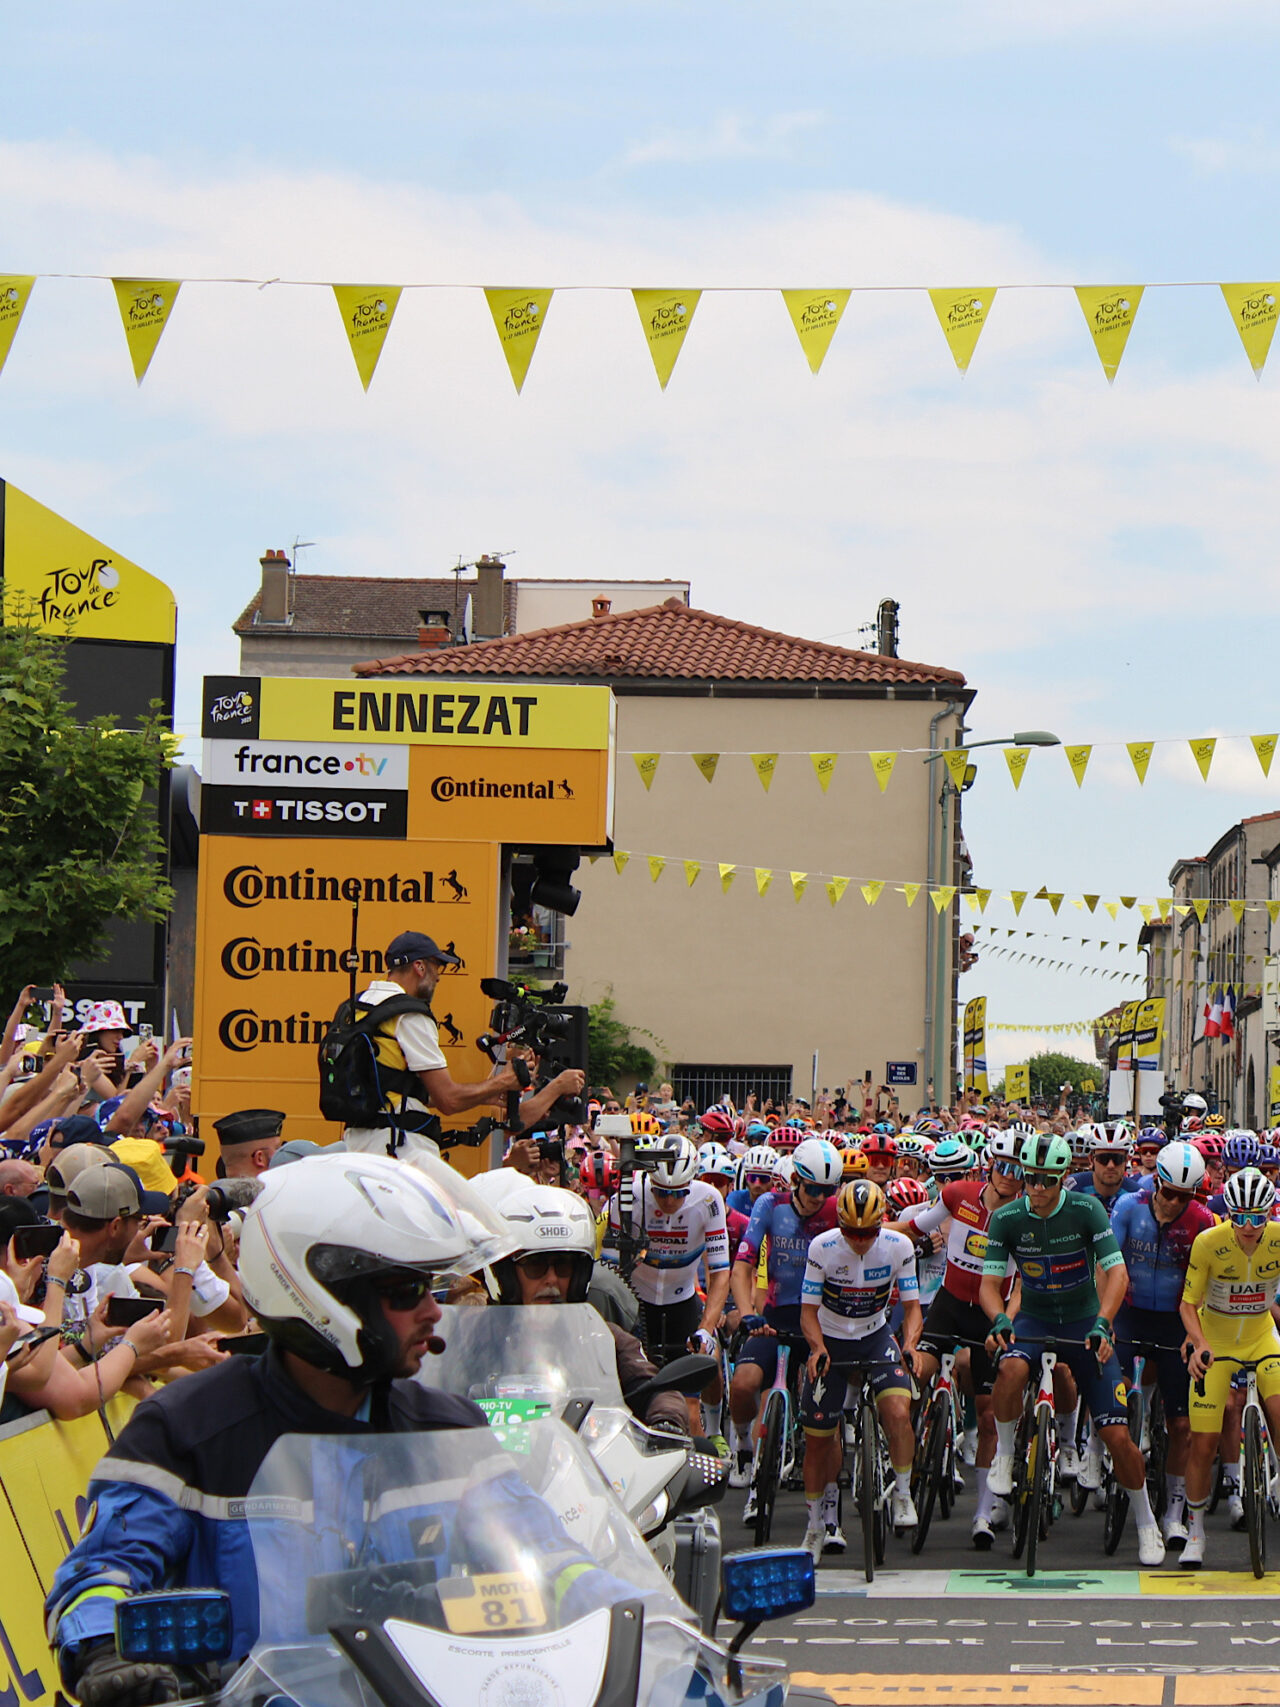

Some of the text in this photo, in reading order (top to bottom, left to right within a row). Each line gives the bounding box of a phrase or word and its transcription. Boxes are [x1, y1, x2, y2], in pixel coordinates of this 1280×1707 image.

[89, 582, 100, 595] de
[332, 690, 538, 736] ENNEZAT
[430, 775, 555, 802] Continental
[276, 800, 387, 823] TISSOT
[223, 864, 435, 908] Continental
[221, 935, 386, 980] Continen
[505, 1025, 527, 1041] RONIN
[960, 1199, 982, 1214] Santini
[539, 1227, 569, 1236] SHOEI
[772, 1236, 807, 1251] ISRAEL
[821, 1240, 838, 1249] Krys
[884, 1234, 900, 1243] Krys
[1215, 1246, 1232, 1257] LCL
[270, 1262, 292, 1293] GARDE
[868, 1268, 887, 1278] Krys
[826, 1276, 855, 1285] Santini
[1230, 1283, 1267, 1294] UAE
[1232, 1294, 1263, 1302] Emirates
[1229, 1303, 1266, 1312] XRG
[1264, 1361, 1280, 1372] LCL
[1192, 1401, 1217, 1410] Santini
[480, 1599, 538, 1628] 81
[1096, 1637, 1199, 1648] Le
[447, 1644, 495, 1658] ESCORTE
